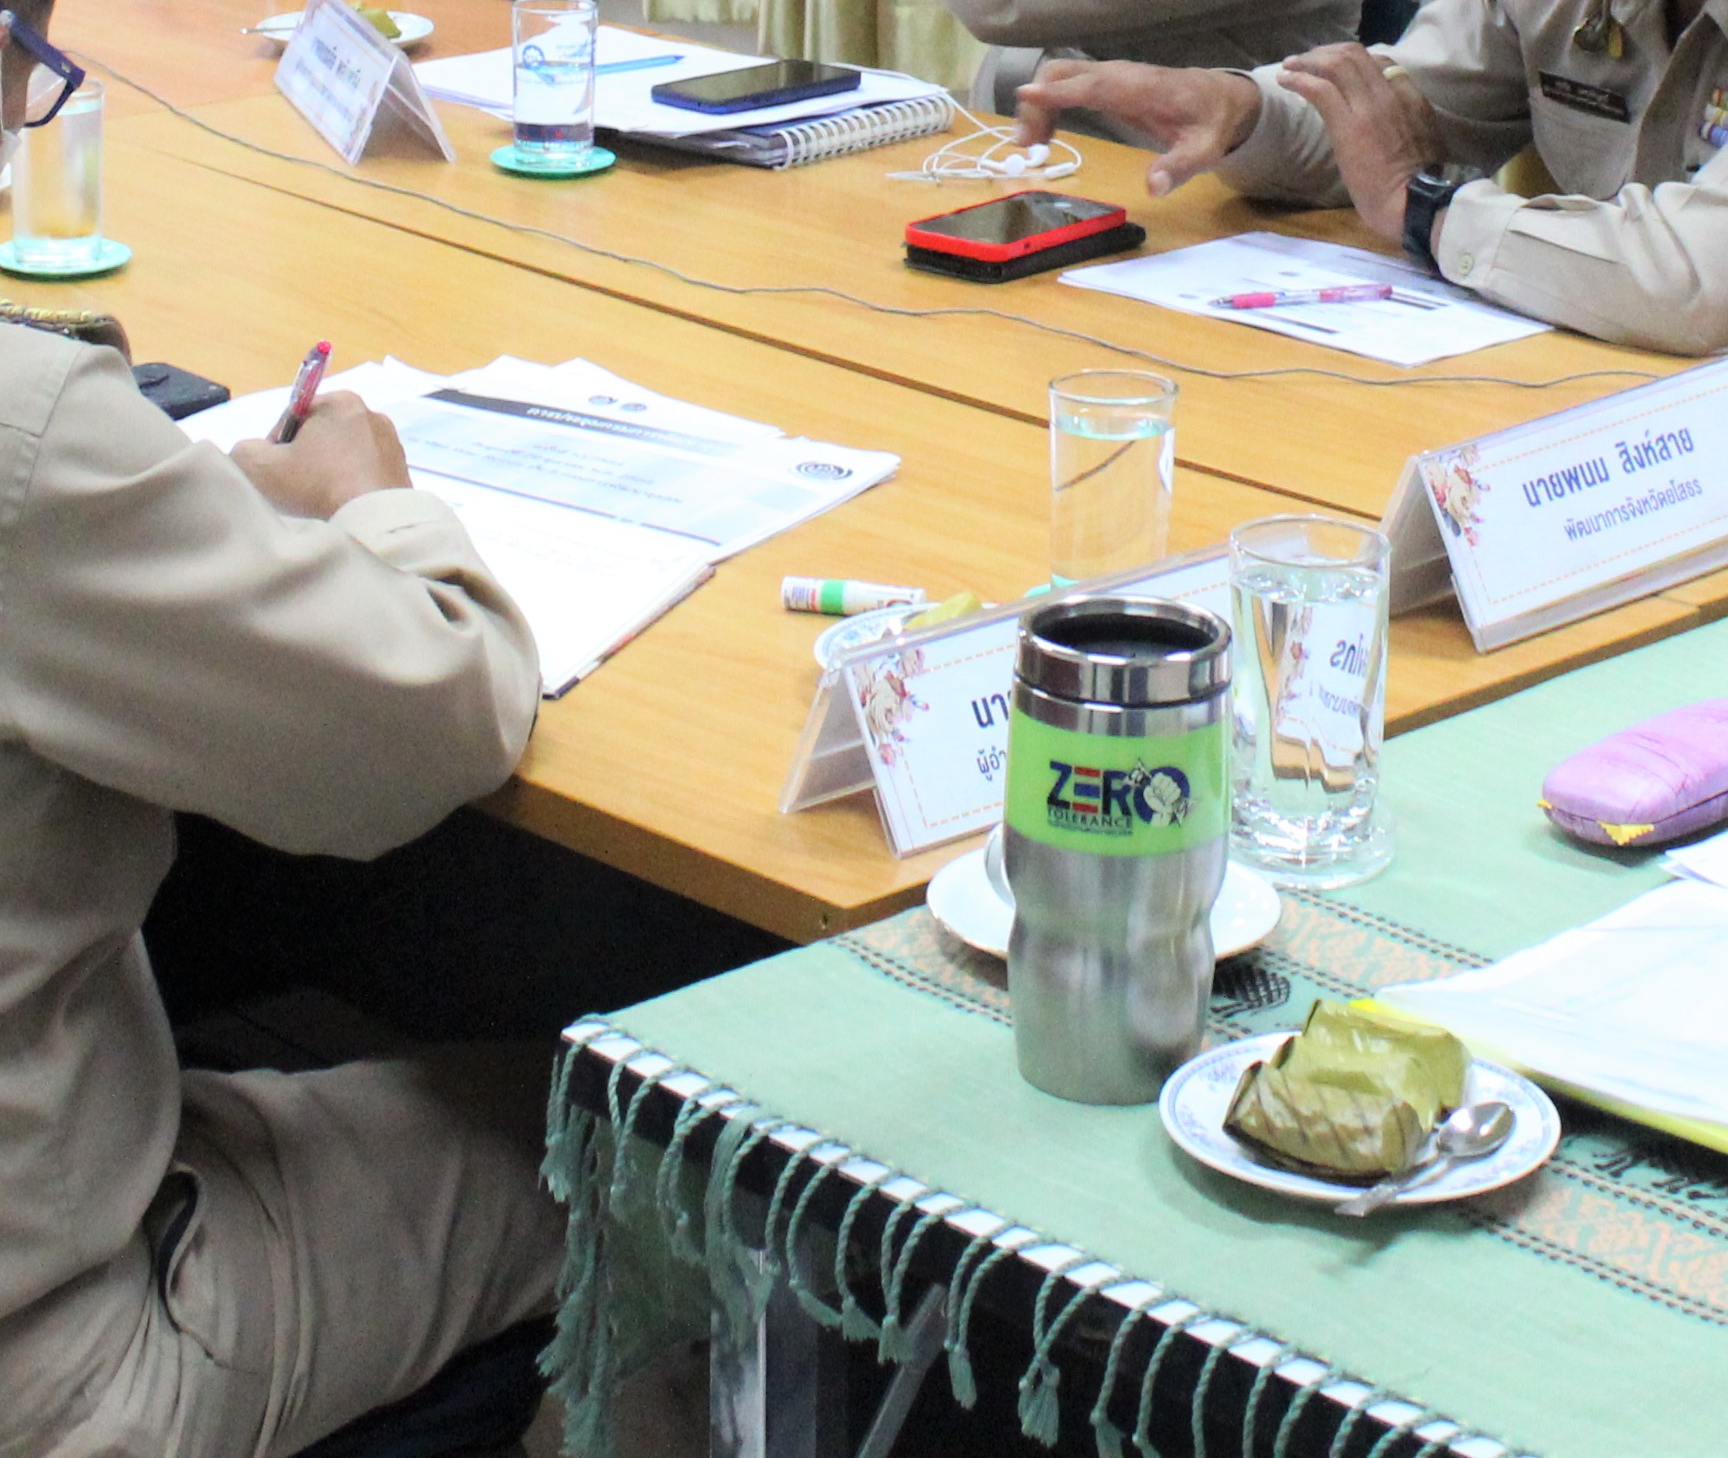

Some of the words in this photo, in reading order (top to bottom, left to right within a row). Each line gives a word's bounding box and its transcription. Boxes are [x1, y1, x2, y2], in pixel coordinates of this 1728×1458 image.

[1522, 456, 1610, 508] นายพนม
[1615, 427, 1695, 475] สิงห์สาย
[1563, 477, 1703, 541] พัฒนาการจังหวัดยโสธร
[971, 690, 1011, 729] นา
[1046, 756, 1192, 828] ZERO
[1047, 804, 1134, 828] TOLERANCE
